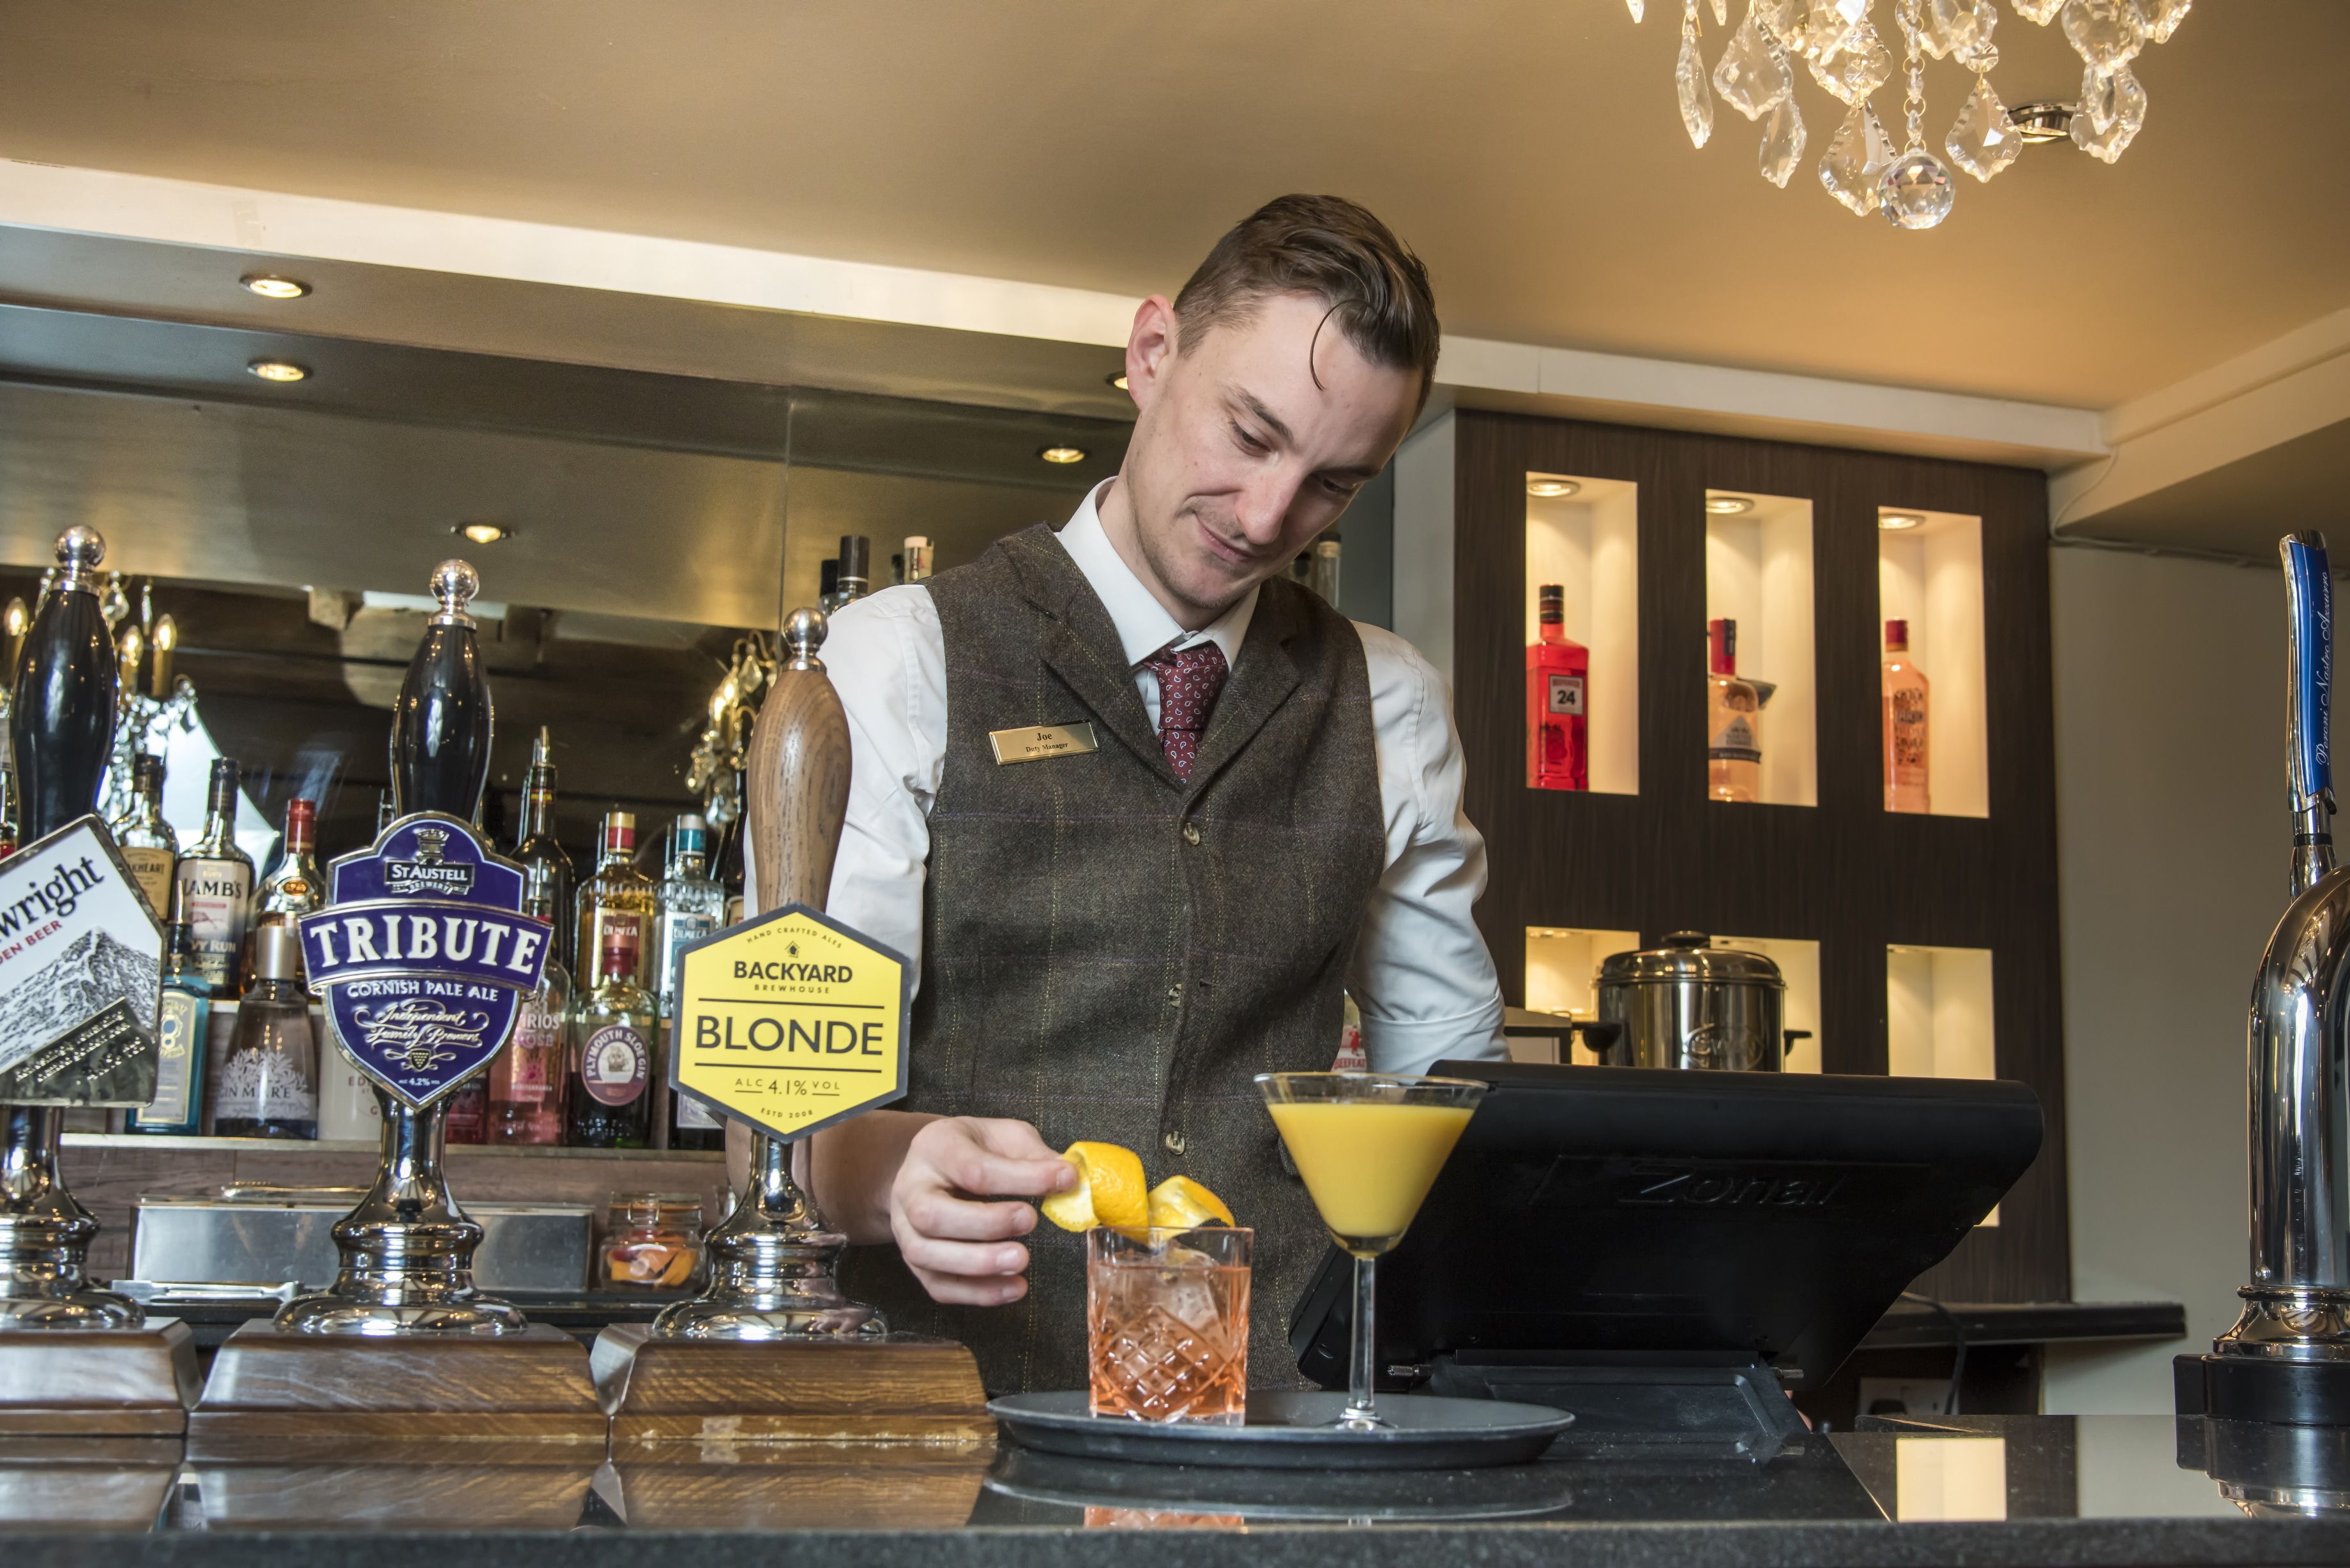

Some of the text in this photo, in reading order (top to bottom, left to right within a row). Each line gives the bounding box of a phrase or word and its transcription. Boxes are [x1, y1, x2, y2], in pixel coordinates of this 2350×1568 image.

[2316, 571, 2330, 765] Peroni Nastro Azzurro
[1557, 690, 1575, 705] 24
[1037, 732, 1053, 741] Joe
[1042, 743, 1068, 751] Manager
[409, 881, 450, 892] BREWERY
[25, 920, 62, 946] BEER
[747, 928, 842, 948] HAND CRAFTED ALES
[310, 915, 542, 974] TRIBUTE
[734, 961, 853, 983] BACKYARD
[347, 980, 499, 1001] CORNISH PALE ALE
[755, 984, 830, 994] BREWHOUSE
[375, 999, 466, 1026] Independent
[365, 1025, 480, 1049] Family Brewers
[696, 1015, 884, 1055] BLONDE
[586, 1029, 646, 1079] PLYMOUTH SLOE GIN
[409, 1078, 430, 1086] 4.2%
[735, 1078, 840, 1095] ALC 4.1% VOL
[242, 1087, 291, 1098] MRE
[761, 1108, 783, 1117] ESTD
[1616, 1165, 1851, 1205] Zonal
